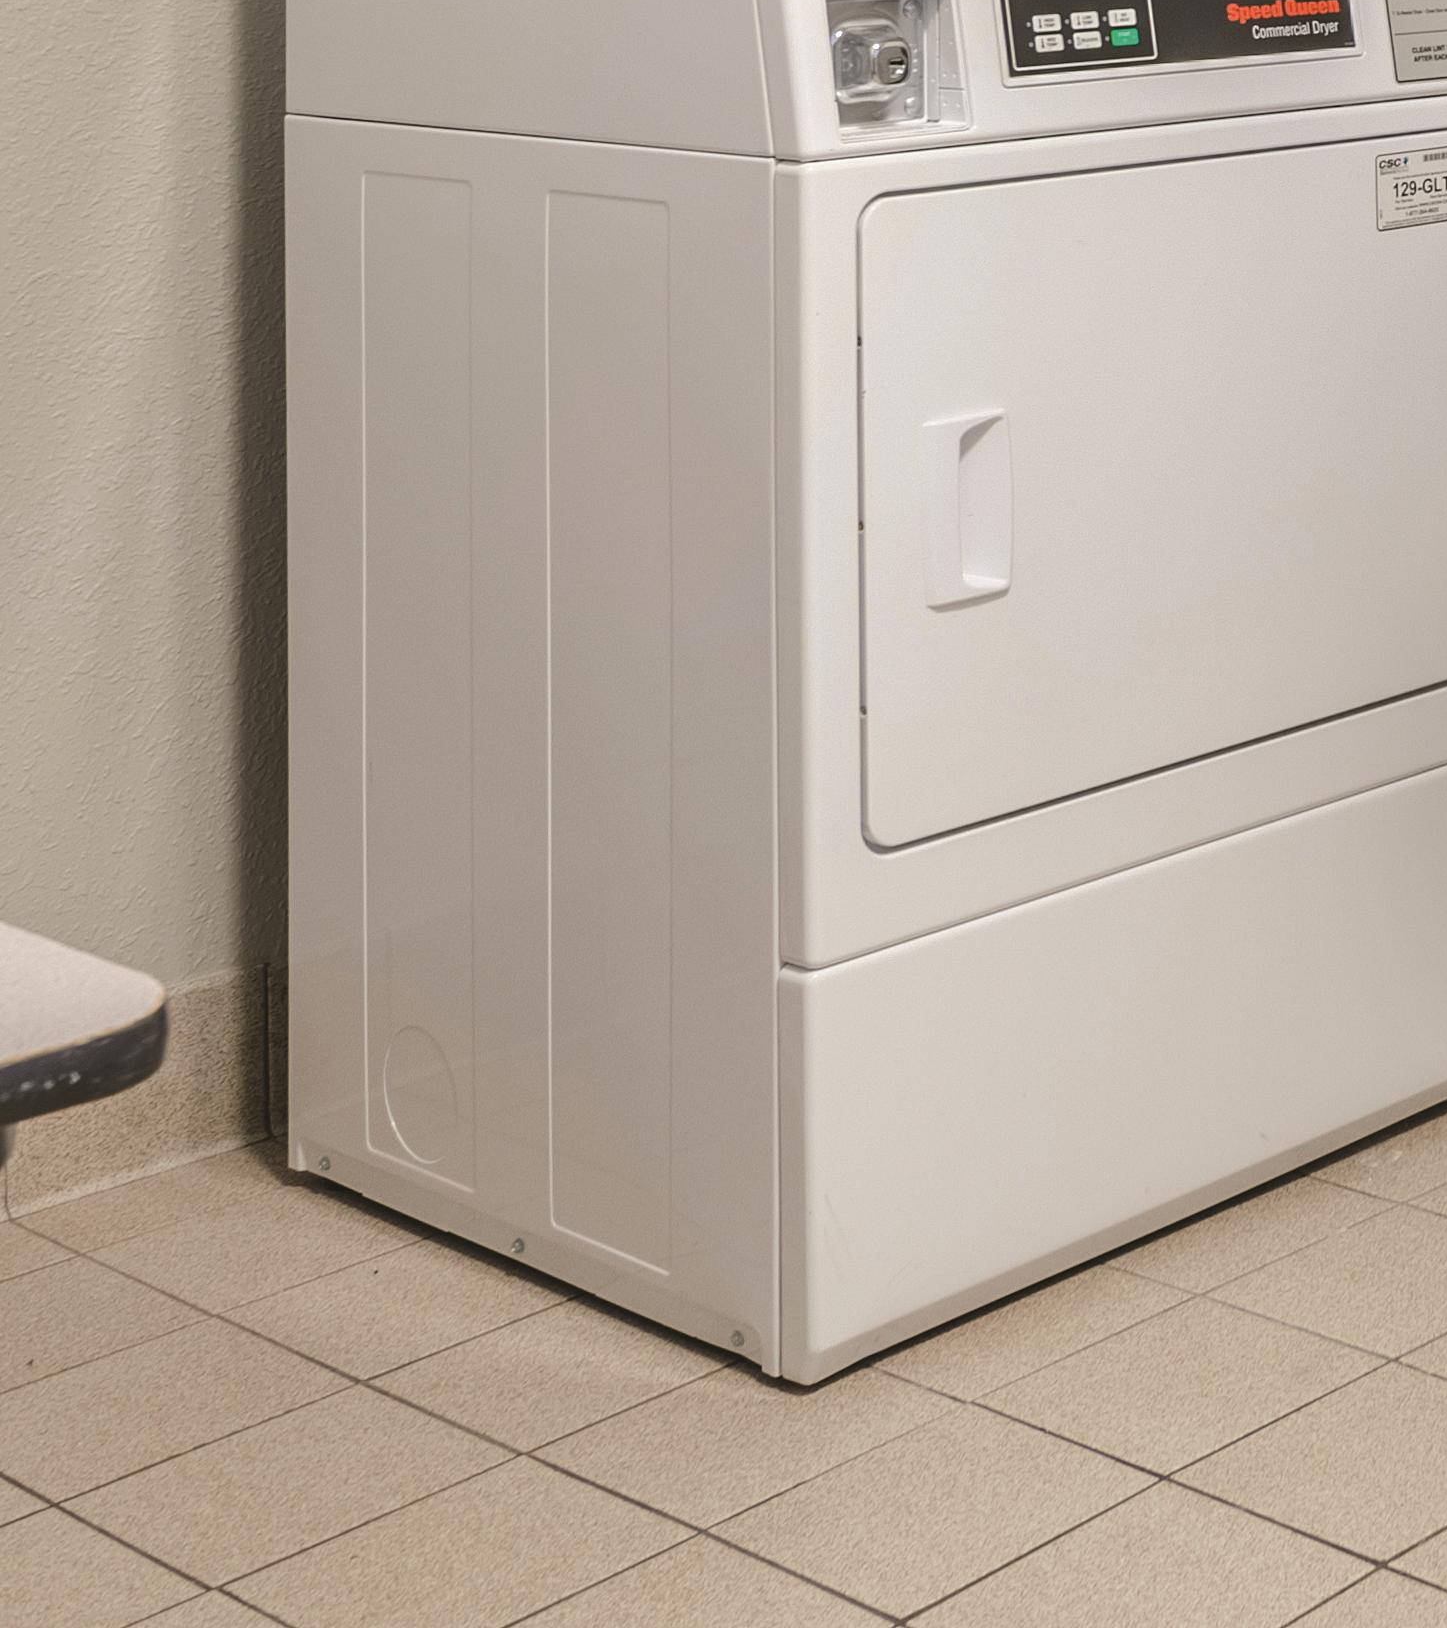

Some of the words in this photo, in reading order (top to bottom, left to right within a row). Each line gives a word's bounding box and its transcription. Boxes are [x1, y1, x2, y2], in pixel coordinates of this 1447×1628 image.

[1226, 1, 1283, 23] Speed
[1286, 0, 1340, 15] Queen
[1253, 23, 1310, 39] Commercial
[1313, 21, 1339, 35] Dryer
[1414, 54, 1432, 62] AFTER
[1379, 158, 1401, 169] CSC
